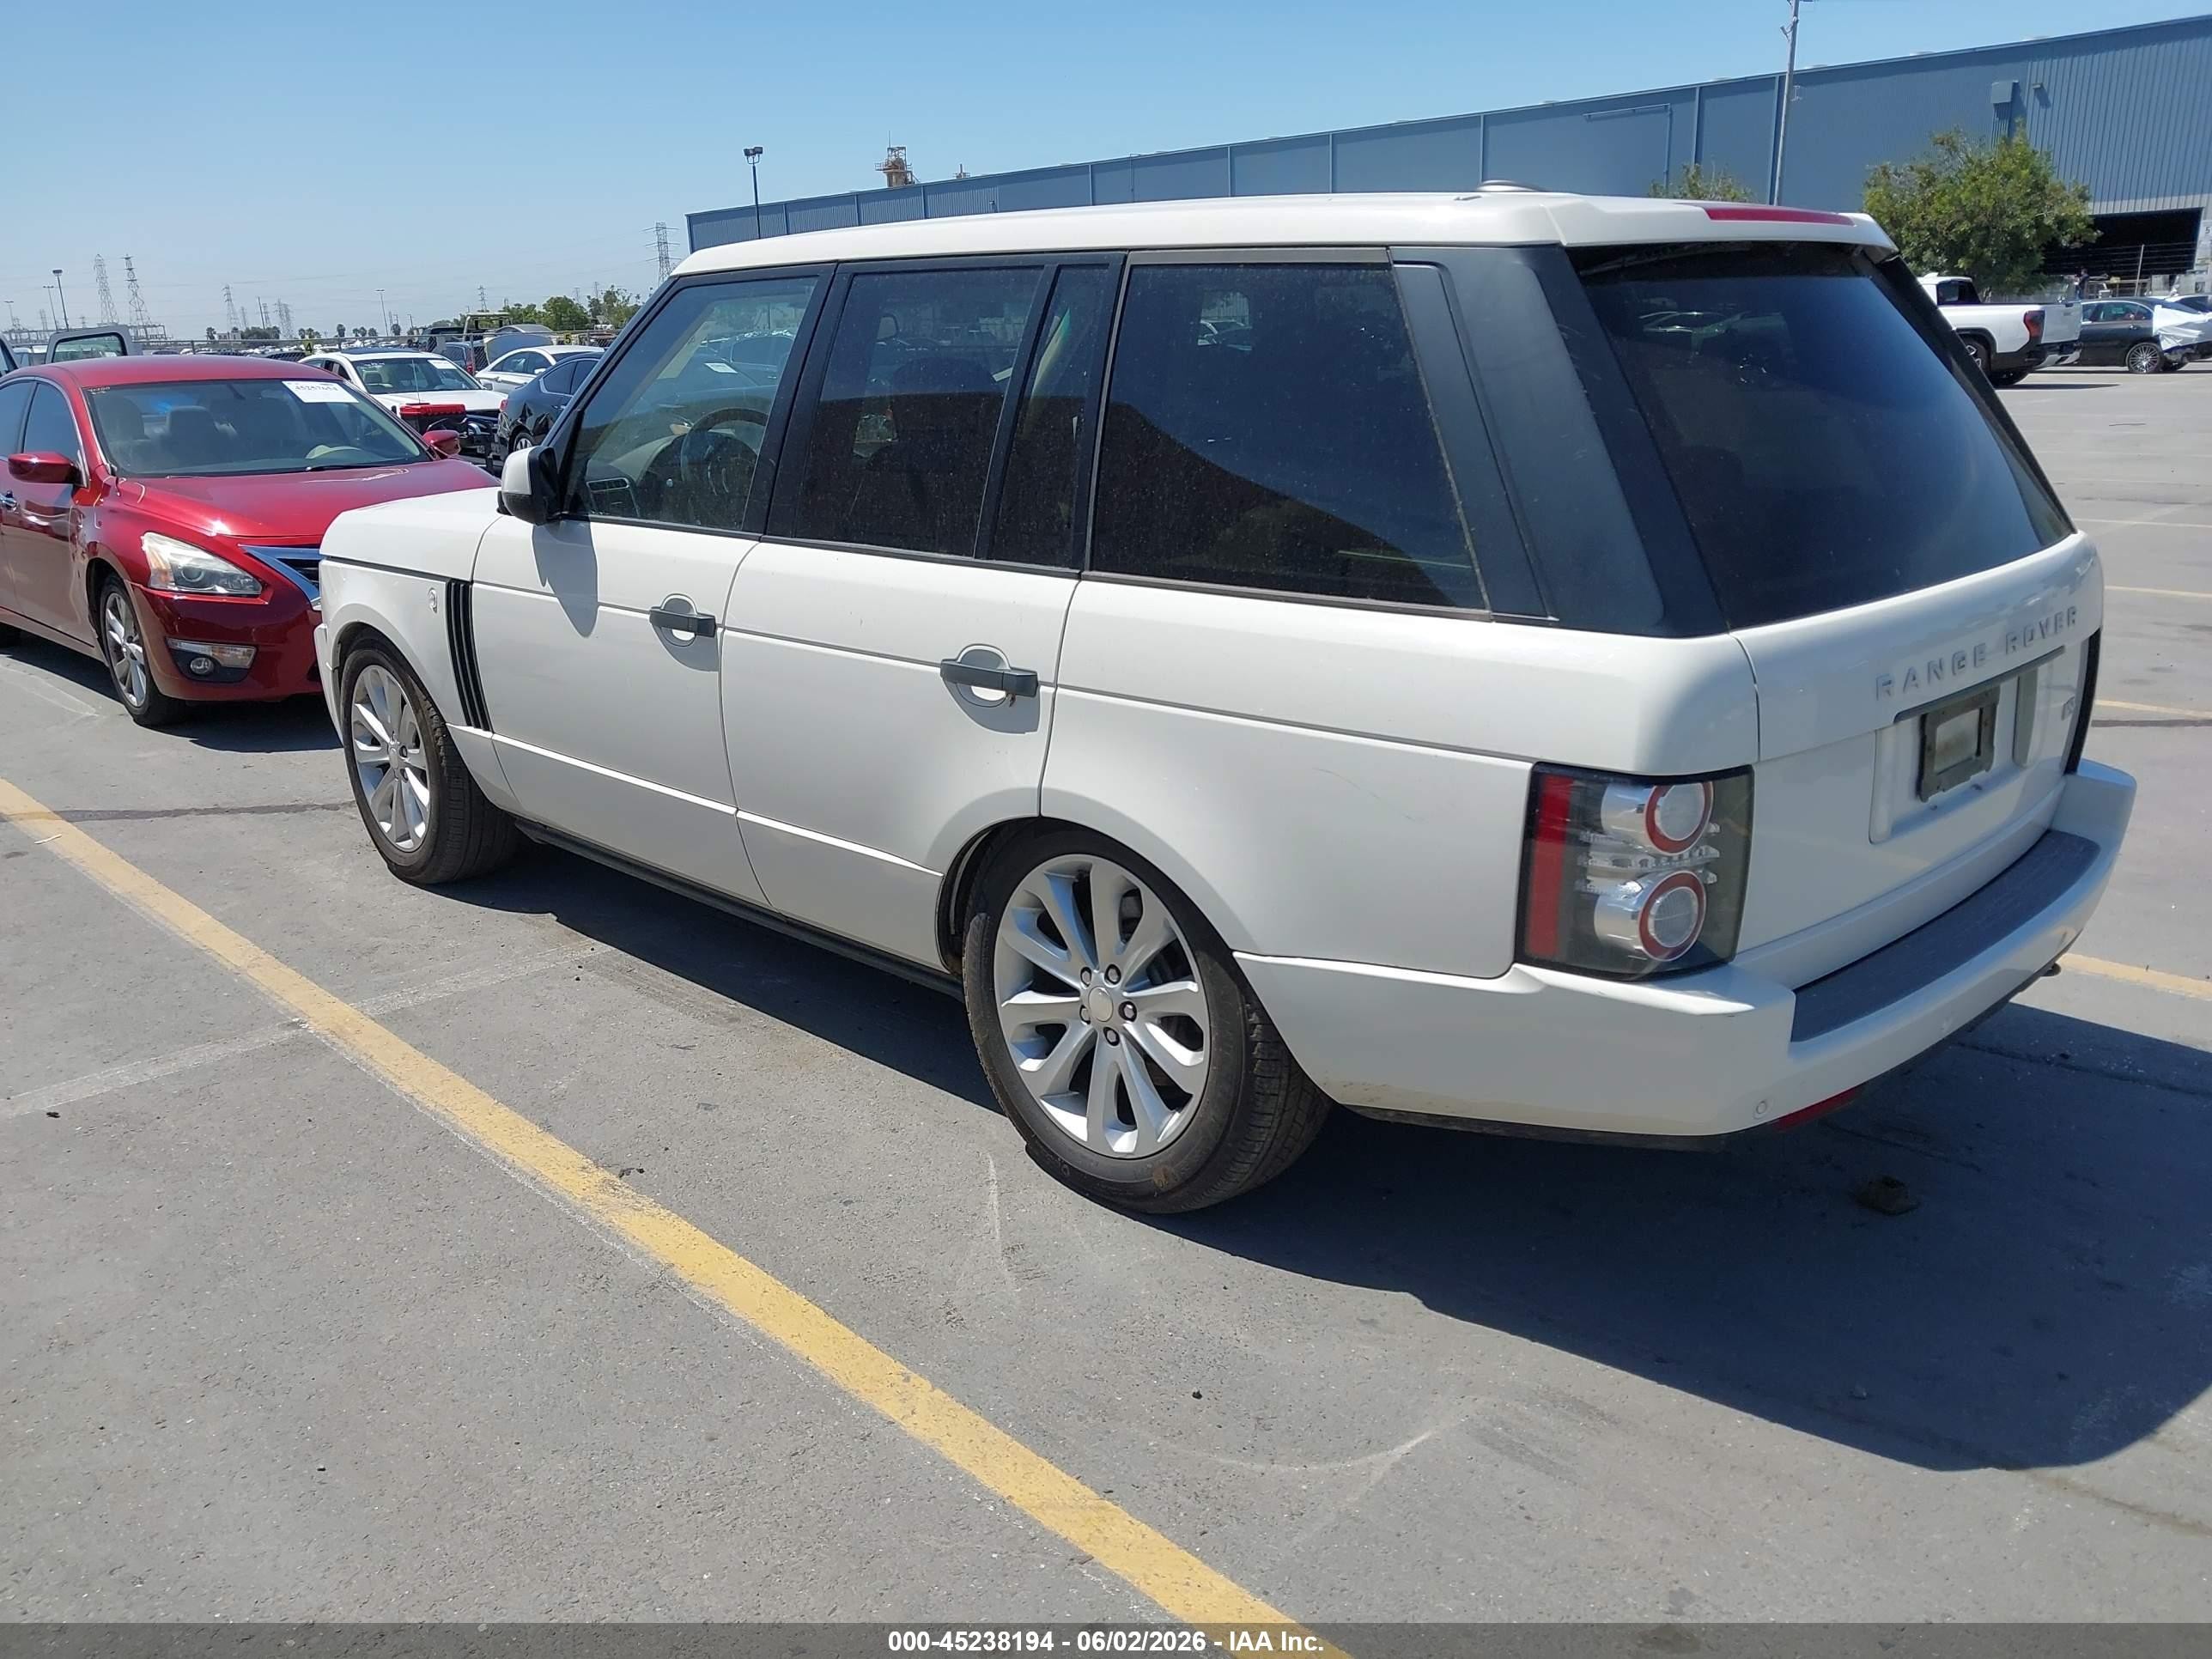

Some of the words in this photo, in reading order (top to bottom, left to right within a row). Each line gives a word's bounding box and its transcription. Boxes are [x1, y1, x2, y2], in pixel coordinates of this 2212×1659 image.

[565, 334, 571, 344] 5
[305, 342, 313, 354] 4
[1875, 642, 1986, 701] RANGE
[2005, 606, 2076, 655] ROVER
